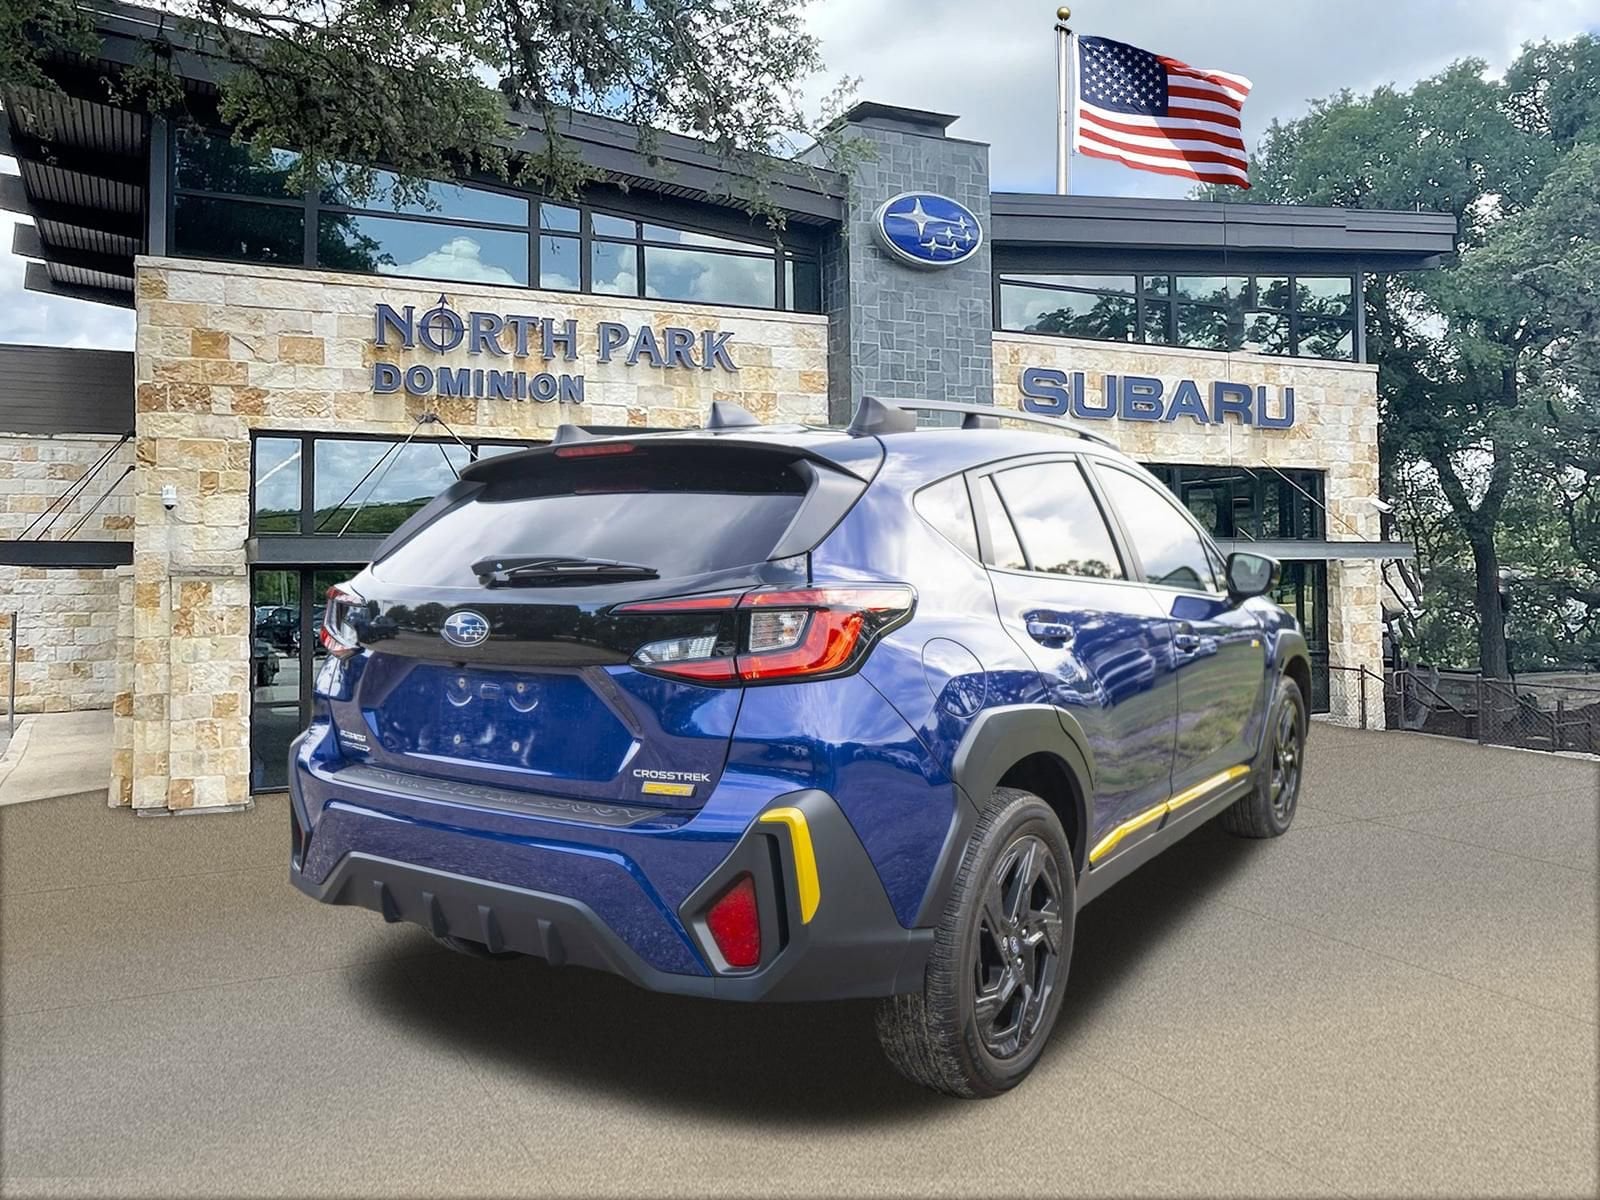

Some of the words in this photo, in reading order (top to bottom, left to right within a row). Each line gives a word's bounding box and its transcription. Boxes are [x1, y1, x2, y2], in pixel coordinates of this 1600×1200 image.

[375, 299, 578, 361] NORTH
[597, 321, 741, 372] PARK
[373, 362, 585, 404] DOMINION
[1019, 367, 1294, 429] SUBARU
[632, 769, 711, 782] CROSSTREK
